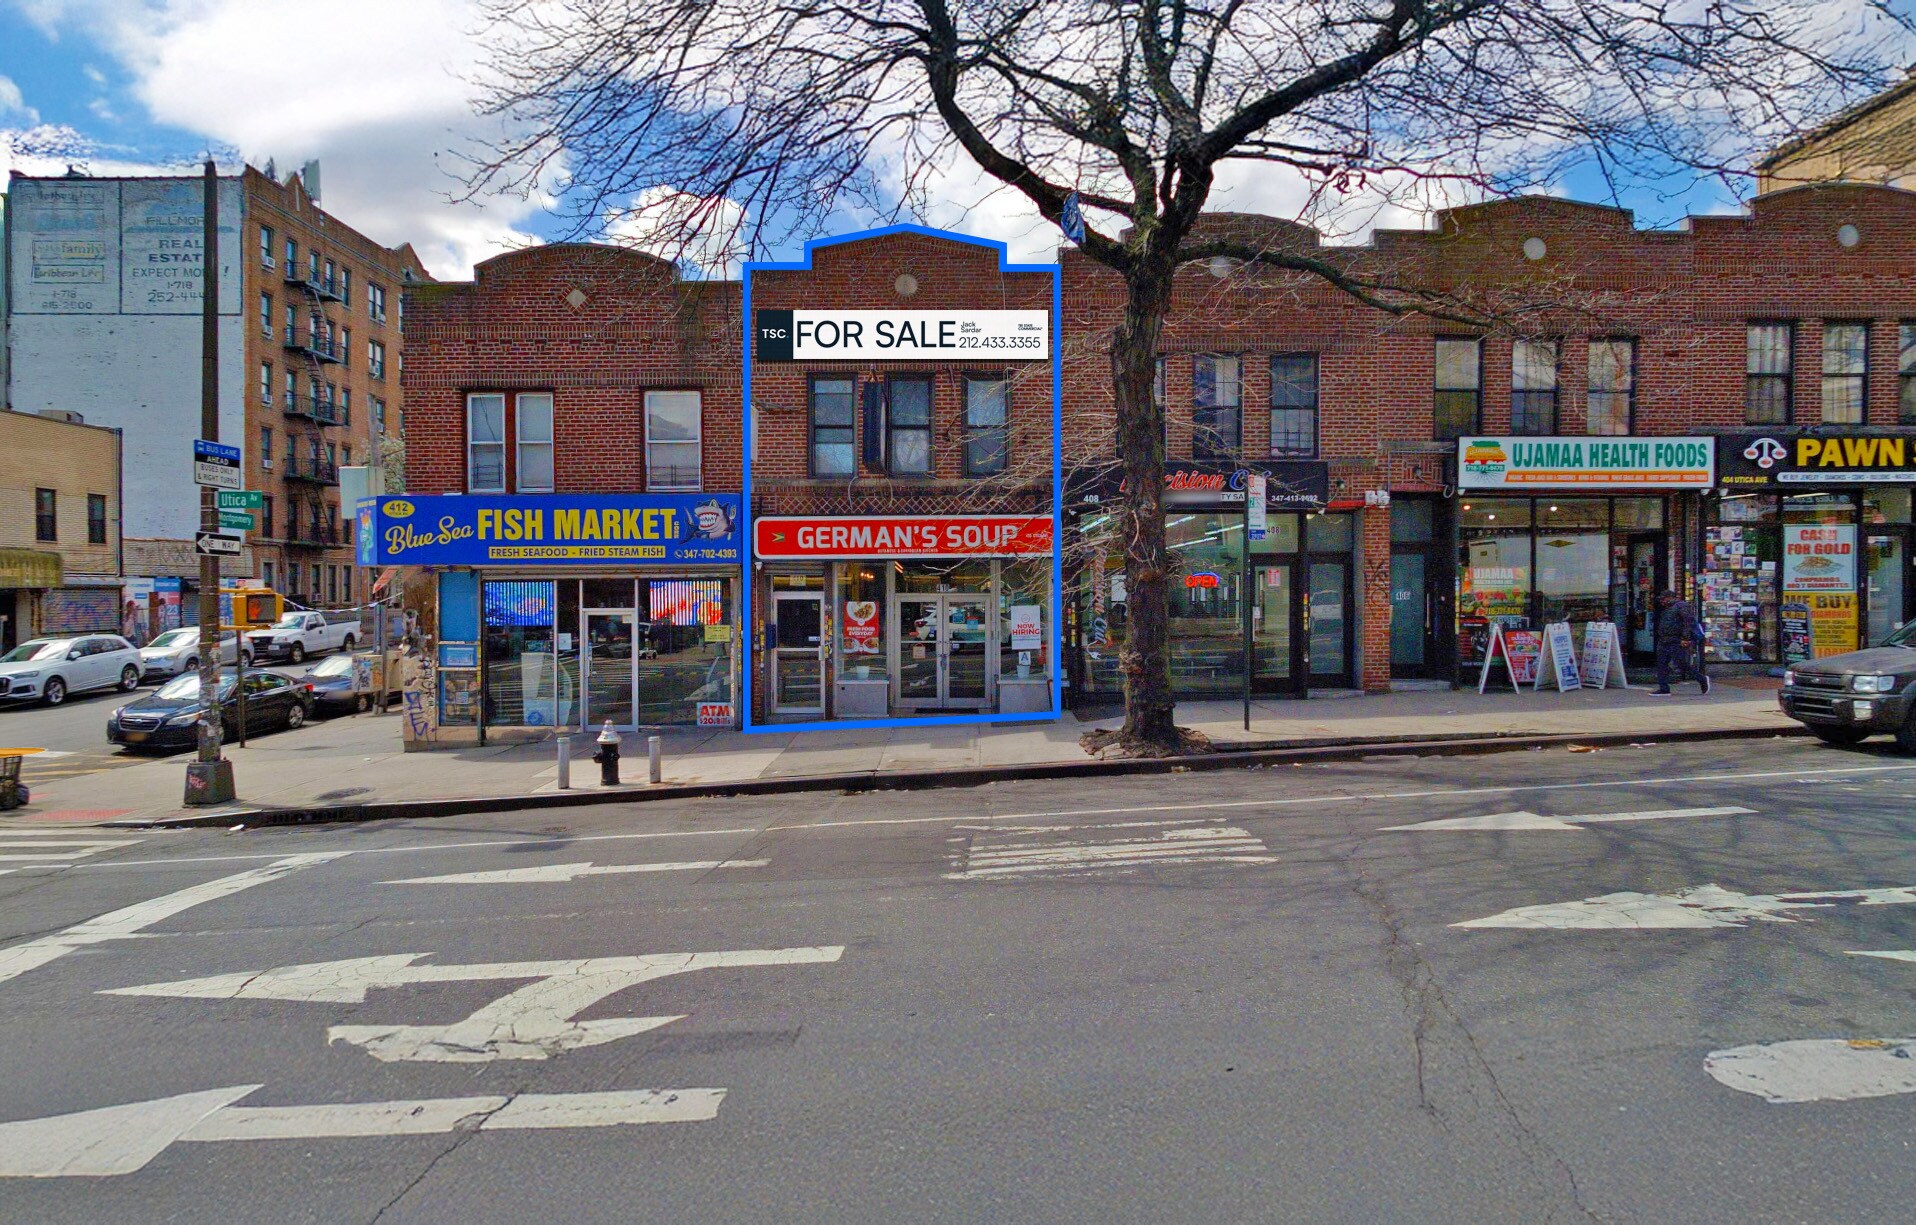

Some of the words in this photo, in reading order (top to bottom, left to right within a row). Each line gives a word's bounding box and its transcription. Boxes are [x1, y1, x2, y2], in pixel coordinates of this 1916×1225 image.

[149, 254, 203, 263] ESTAT
[132, 268, 178, 277] EXPECT
[206, 445, 219, 453] BUS
[221, 448, 238, 457] LANE
[1513, 443, 1584, 468] UJAMAA
[1589, 443, 1649, 468] HEALTH
[1655, 443, 1707, 468] FOODS
[1797, 438, 1905, 467] PAWN
[206, 455, 229, 466] AHEAD
[201, 463, 219, 473] BUSES
[221, 493, 247, 507] Utica
[1083, 494, 1099, 503] 408
[389, 503, 408, 512] 412
[477, 508, 543, 540] FISH
[553, 508, 677, 540] MARKET
[385, 523, 434, 554] Blue
[439, 515, 474, 544] Sea
[797, 526, 937, 548] GERMAN'S
[946, 525, 1018, 547] SOUP
[1800, 529, 1837, 540] CASH
[201, 539, 214, 548] ONE
[222, 541, 235, 550] WAY
[1787, 543, 1810, 555] FOR
[1814, 543, 1851, 554] GOLD
[491, 548, 520, 557] FRESH
[523, 547, 568, 557] SEAFOOD
[579, 547, 605, 556] FRIED
[608, 547, 640, 556] STEAM
[642, 547, 664, 556] FISH
[1185, 575, 1218, 588] OPEN
[1816, 595, 1852, 608] BUY
[1020, 652, 1028, 661] A
[701, 705, 730, 717] ATM
